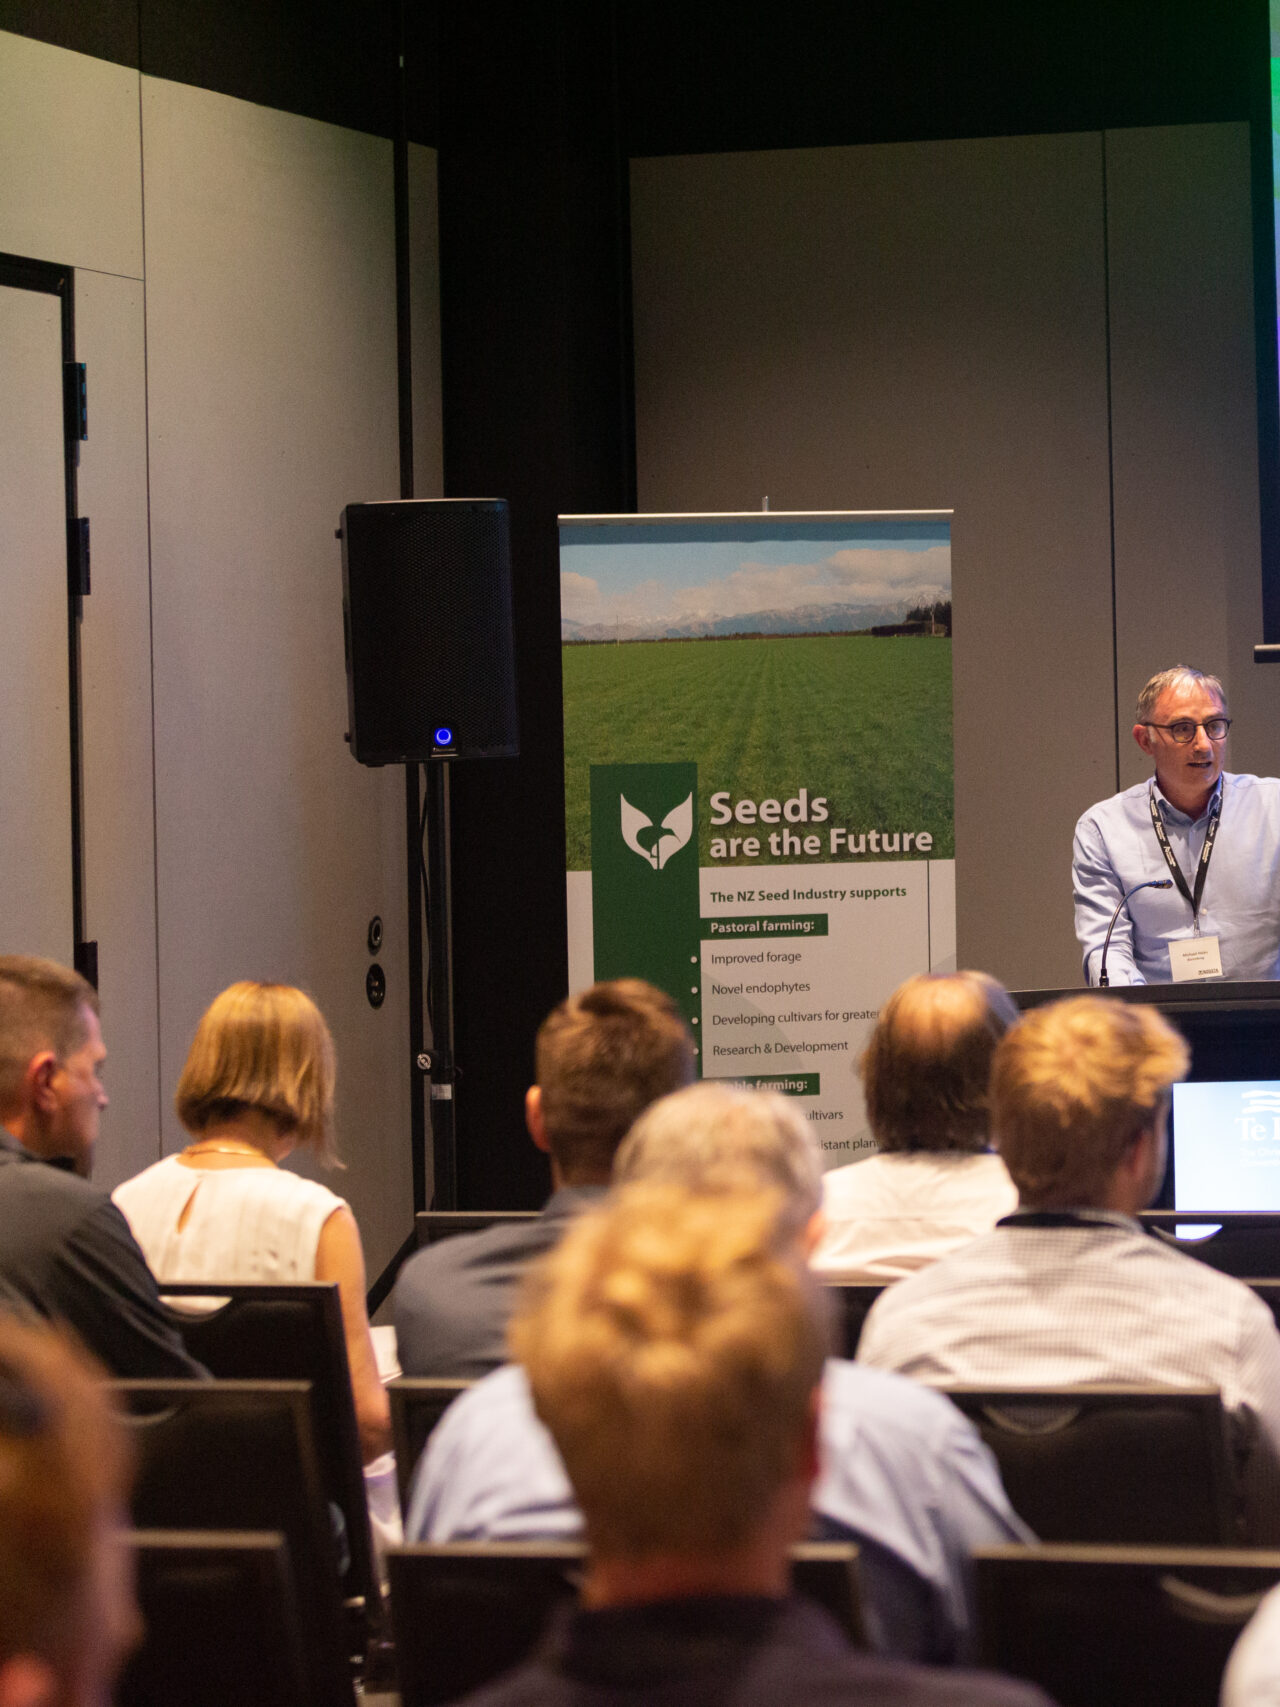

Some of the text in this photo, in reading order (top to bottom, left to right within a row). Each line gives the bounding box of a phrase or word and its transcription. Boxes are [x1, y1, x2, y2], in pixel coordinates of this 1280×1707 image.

[709, 788, 829, 825] Seeds
[709, 828, 933, 858] are the Future
[710, 886, 907, 903] The NZ Seed Industry supports
[710, 919, 815, 933] Pastoral farming:
[711, 951, 802, 966] Improved forage
[712, 982, 811, 996] Novel endophytes
[712, 1013, 775, 1027] Developing
[778, 1011, 822, 1022] cultivars
[824, 1010, 839, 1021] for
[713, 1040, 848, 1056] Research & Development
[756, 1078, 808, 1093] farming:
[805, 1109, 844, 1121] ultivars
[1235, 1117, 1266, 1141] Te
